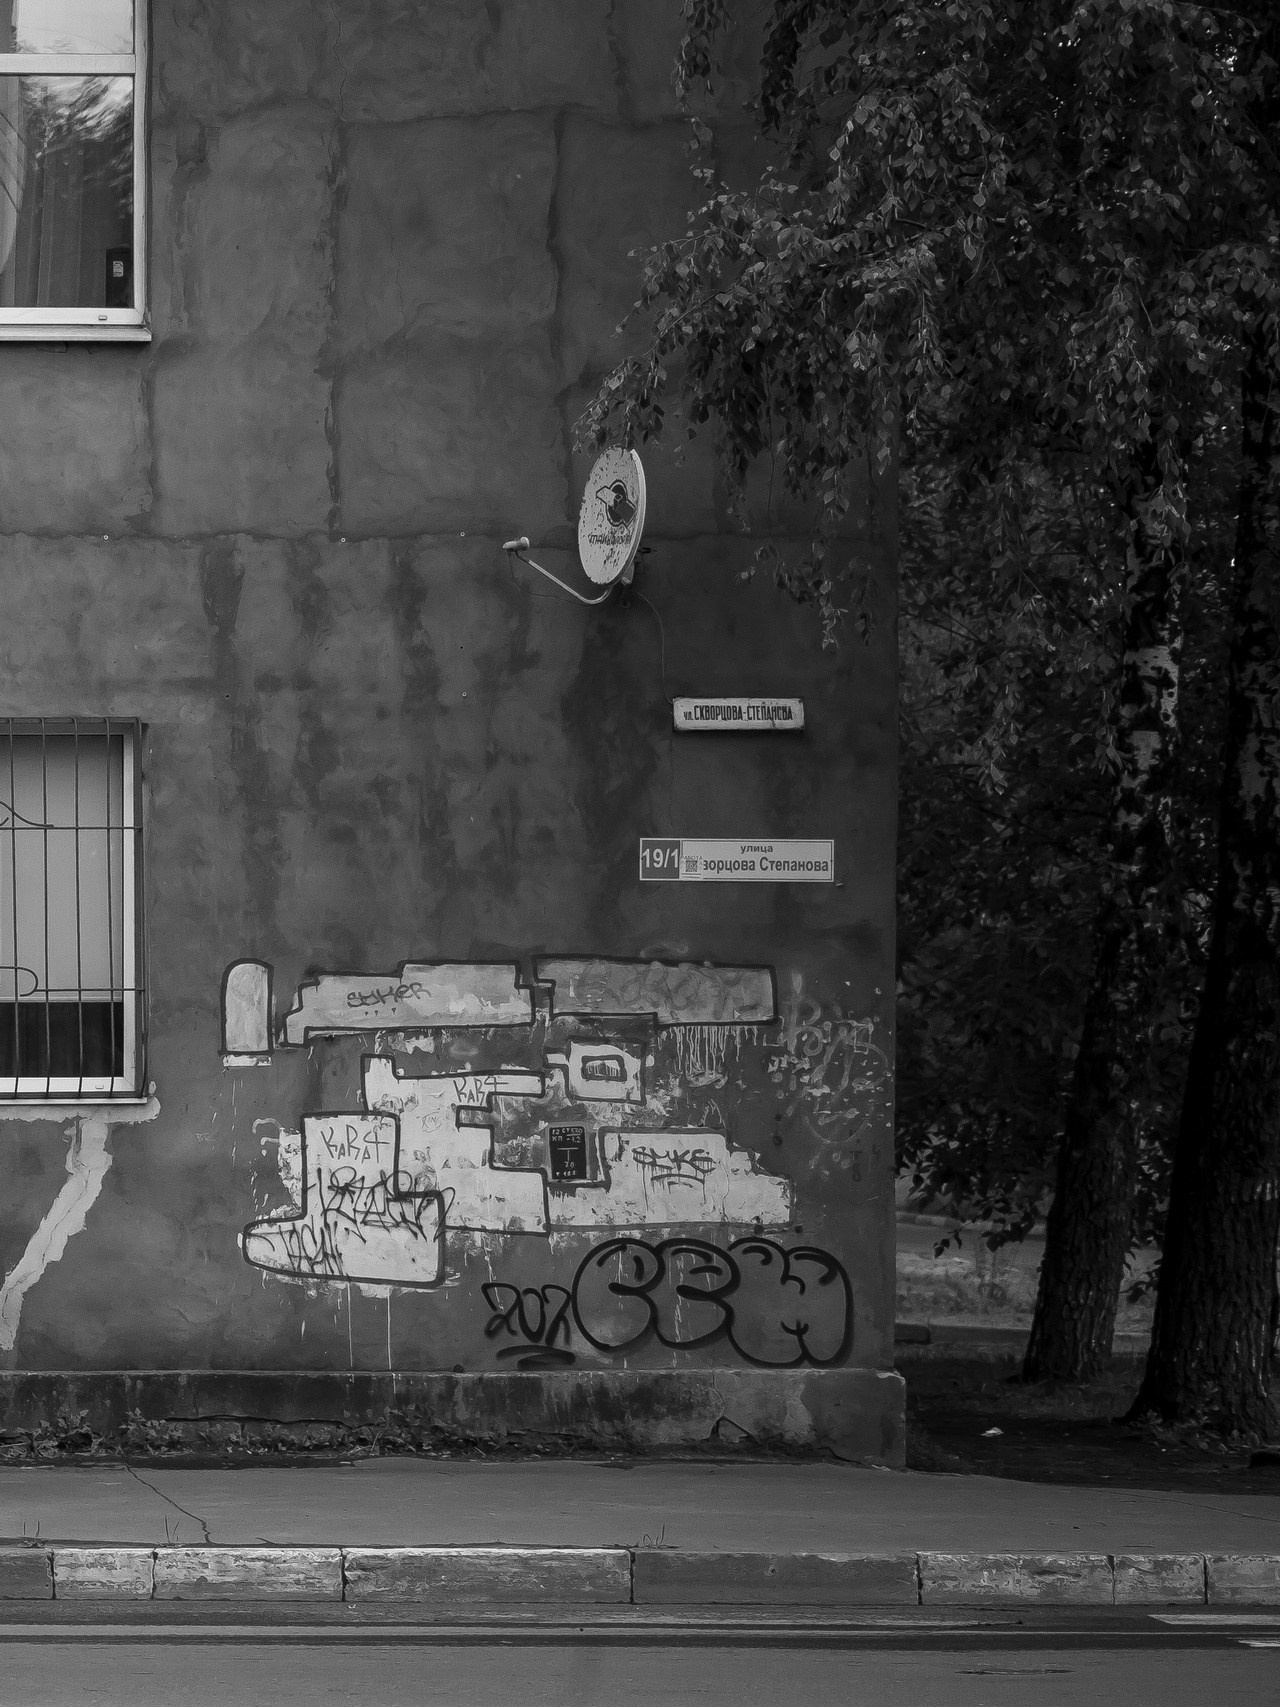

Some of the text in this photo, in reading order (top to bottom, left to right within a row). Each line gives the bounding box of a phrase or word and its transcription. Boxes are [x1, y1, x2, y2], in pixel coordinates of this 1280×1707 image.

[683, 711, 693, 721] ул.
[740, 844, 774, 854] улица
[641, 848, 679, 869] 19/1
[702, 857, 829, 874] ворцова Степанова
